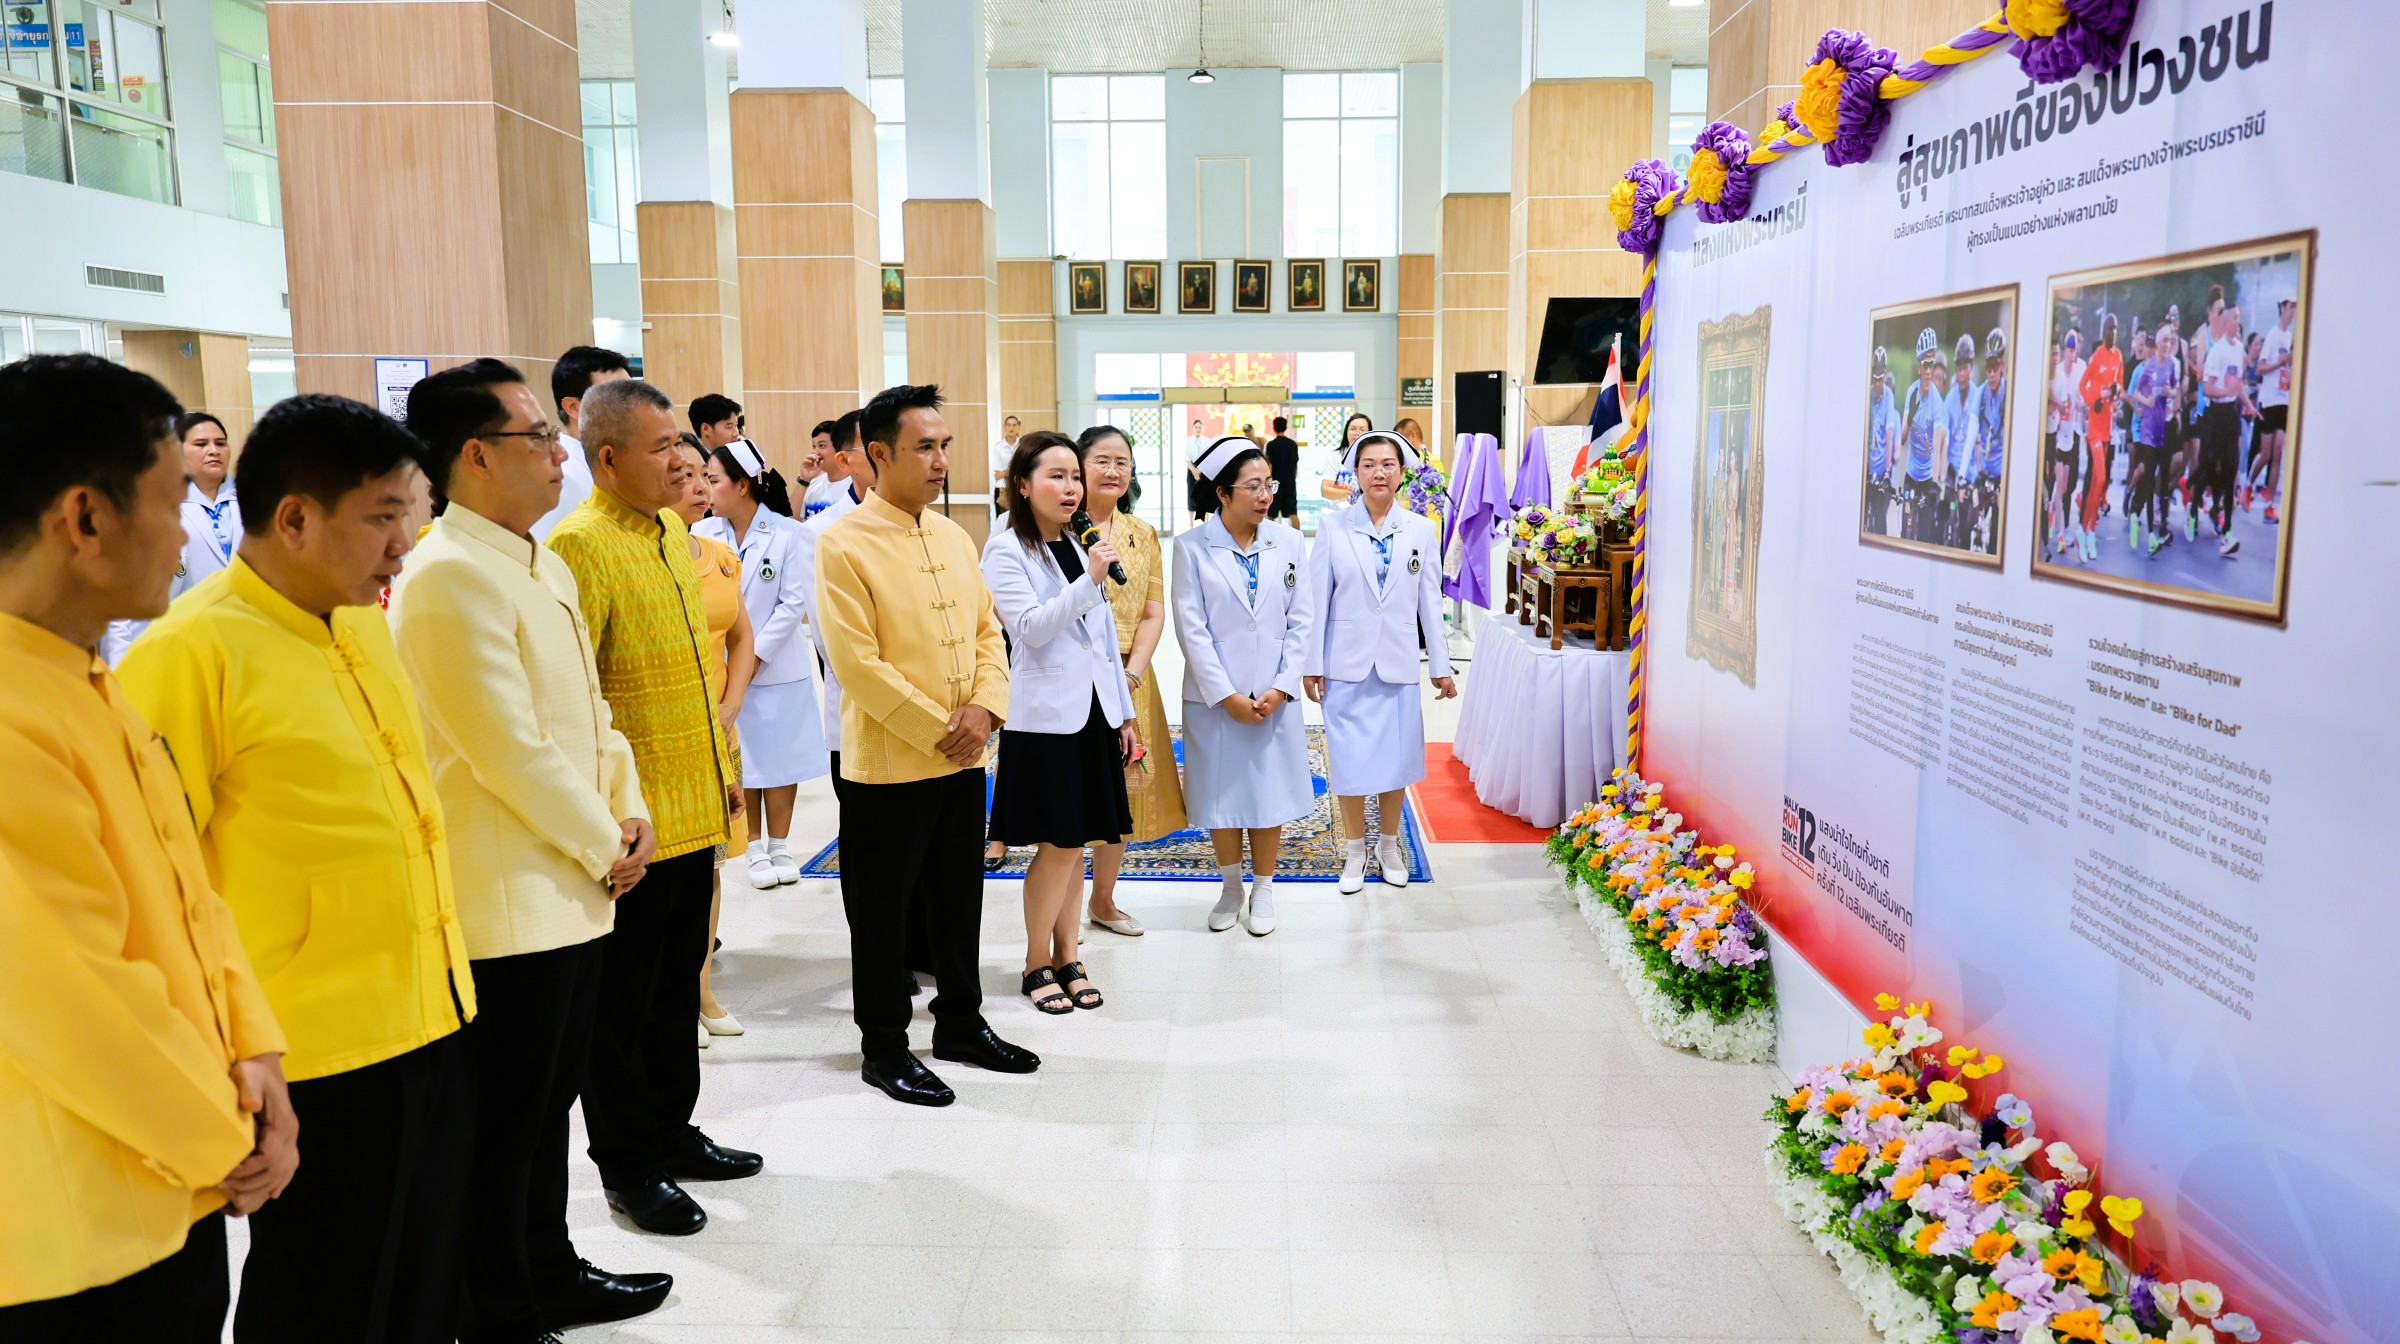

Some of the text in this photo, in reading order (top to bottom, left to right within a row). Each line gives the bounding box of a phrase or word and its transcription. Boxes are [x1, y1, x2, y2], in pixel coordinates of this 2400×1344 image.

[1896, 1, 2274, 209] สู่สุขภาพดีของปวงชน
[1893, 110, 2266, 240] เฉลิมพระเกียรติ พระบาทสมเด็จพระเจ้าอยู่หัว และ สมเด็จพระนางเจ้าพระบรมราชินี
[1966, 195, 2118, 253] ผู้ทรงเป็นแบบอย่างแห่งพลานามัย
[2089, 637, 2242, 689] รวมใจคนไทยสู่การสร้างเสริมสุขภาพ
[2109, 685, 2123, 701] for
[2151, 699, 2168, 715] และ
[2197, 713, 2213, 730] for
[1782, 808, 1799, 833] RUN
[1783, 794, 1800, 815] WALK
[1781, 827, 1798, 851] BIKE
[1798, 807, 1816, 865] 12
[1819, 818, 1890, 879] แสงนำใจไทยทั้งชาติ
[1816, 867, 1906, 954] ครั้งที่ 12 เฉลิมพระเกียรติ
[1817, 844, 1913, 928] เดิน วิ่ง ปั่น ป้องกันอัมพาต
